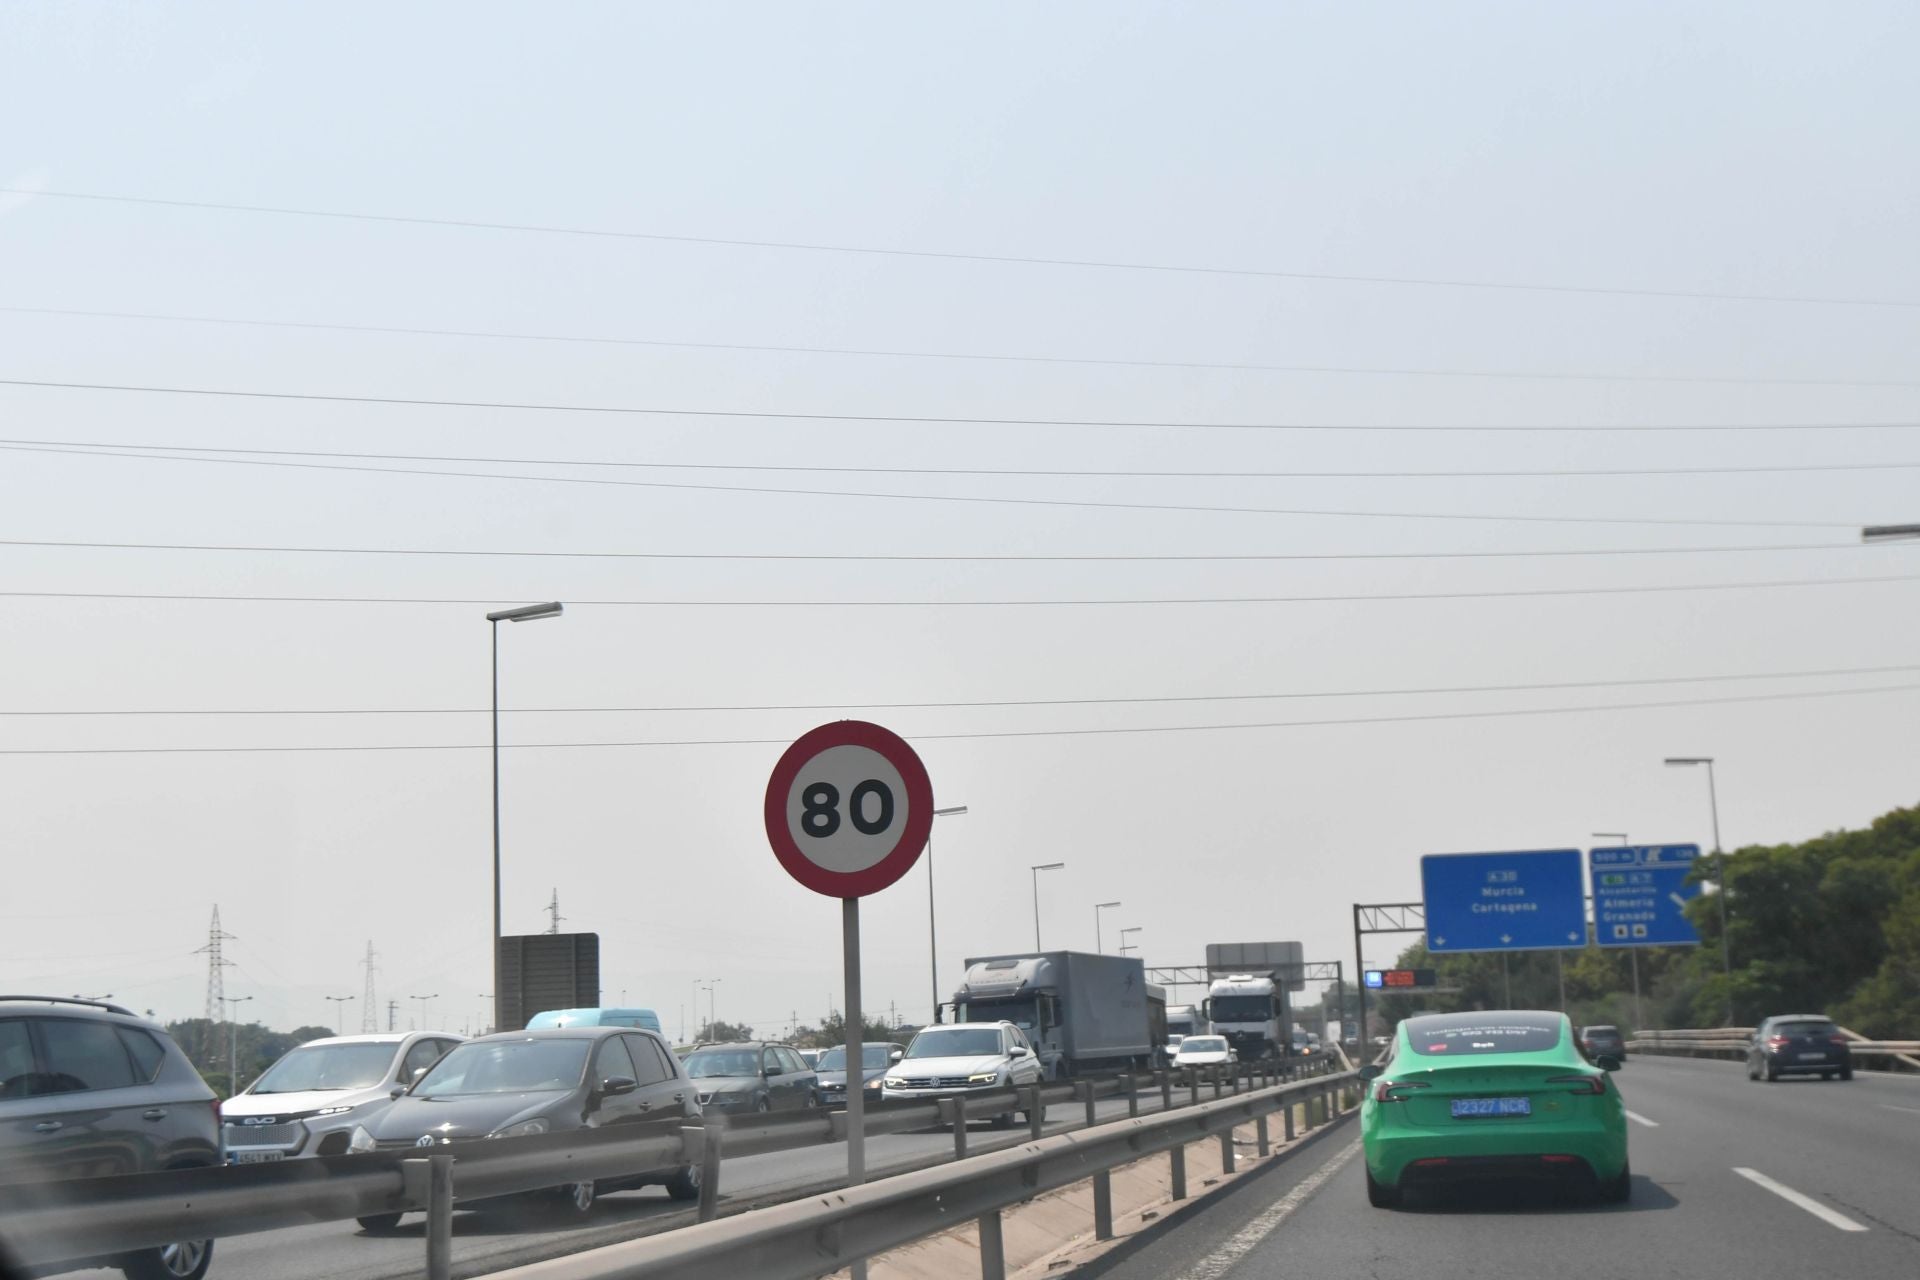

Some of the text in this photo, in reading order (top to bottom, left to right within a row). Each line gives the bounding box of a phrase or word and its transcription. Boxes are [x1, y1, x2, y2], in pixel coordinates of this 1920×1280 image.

[801, 779, 894, 838] 80
[1482, 886, 1525, 896] Murcia
[1472, 902, 1537, 915] Cartagena
[1603, 911, 1655, 921] Granada
[1461, 1099, 1527, 1113] 2327 NCR
[244, 1116, 276, 1125] EVO
